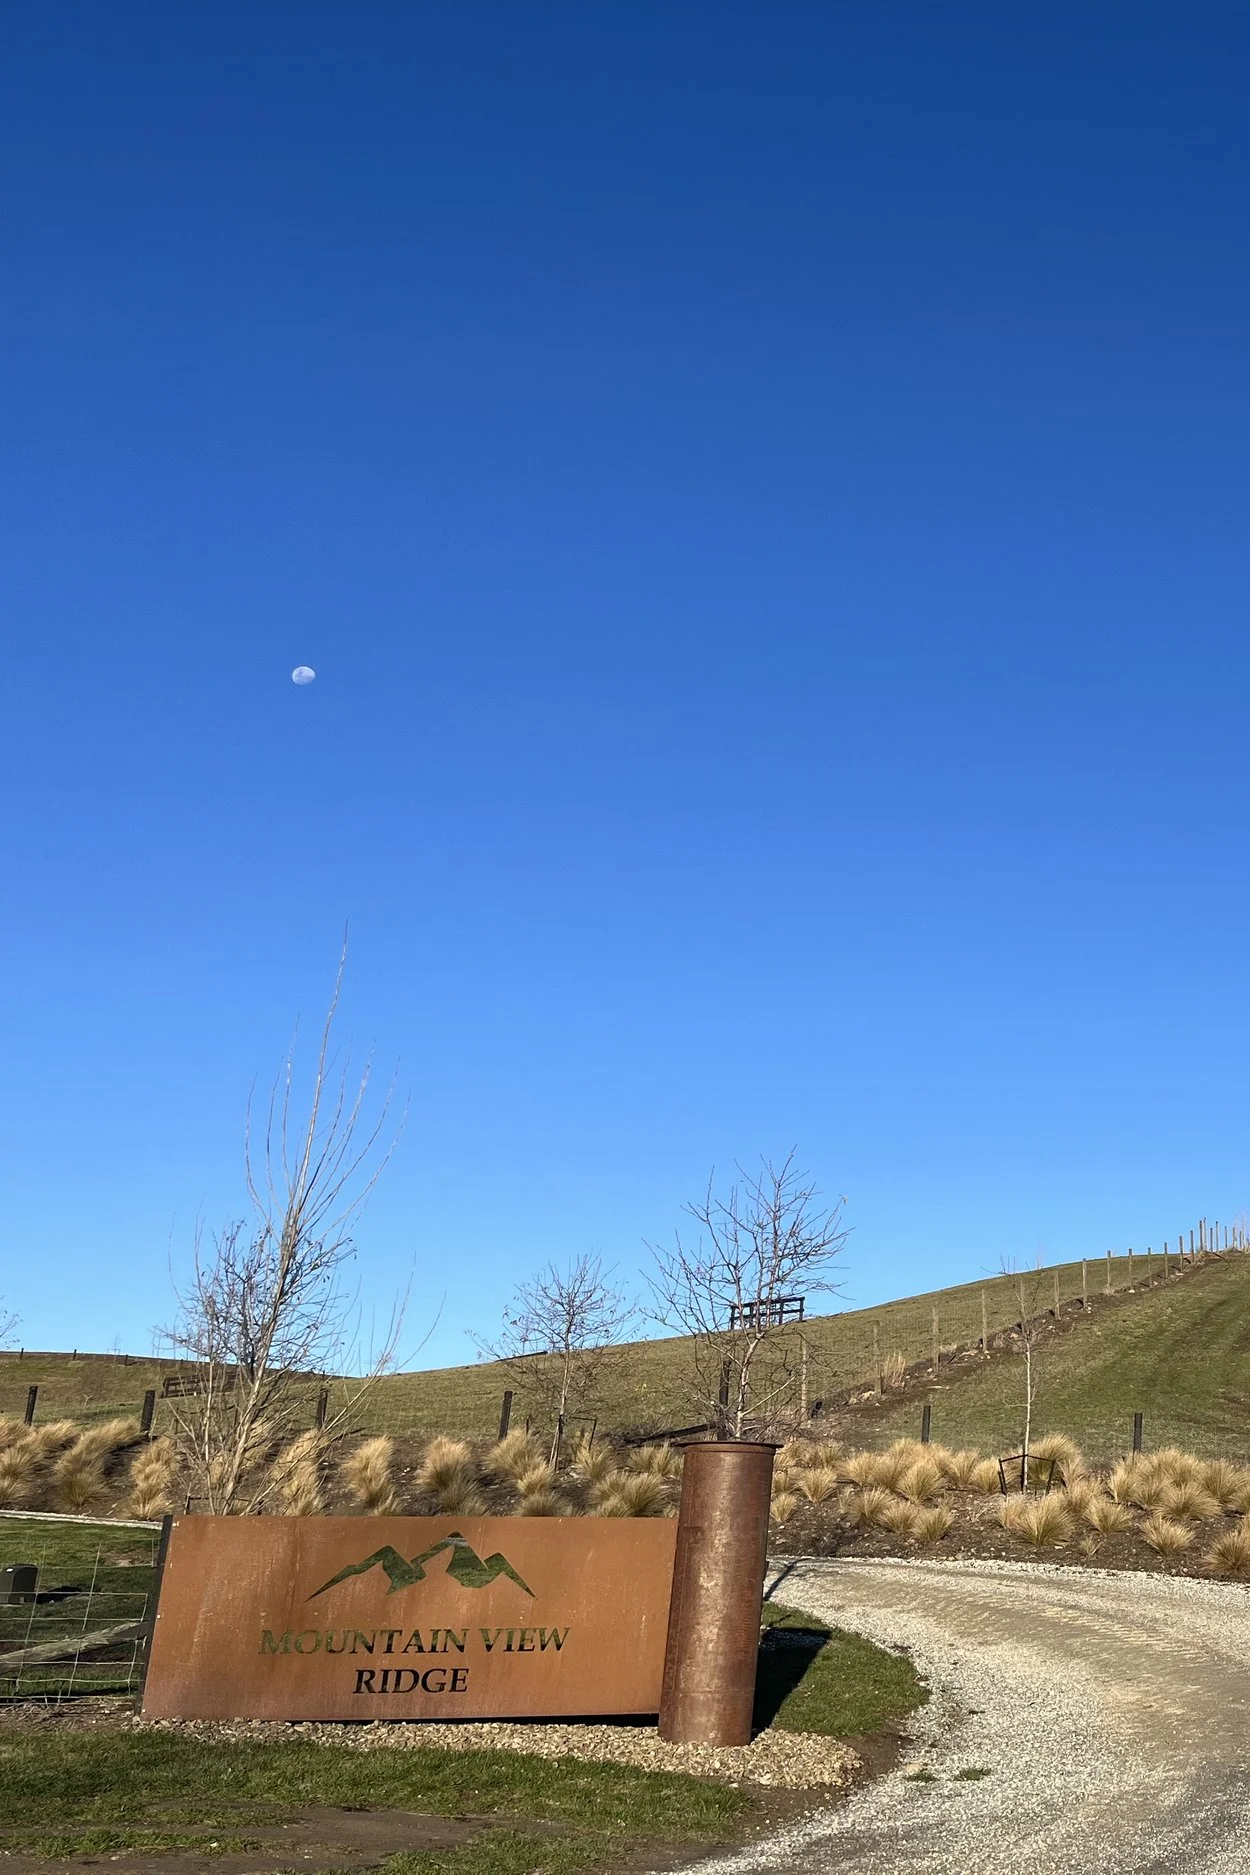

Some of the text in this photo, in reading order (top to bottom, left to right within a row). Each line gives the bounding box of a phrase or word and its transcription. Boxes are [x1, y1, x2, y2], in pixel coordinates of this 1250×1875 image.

[258, 1627, 570, 1654] MOUNTAIN VIEW
[352, 1668, 469, 1694] RIDGE
